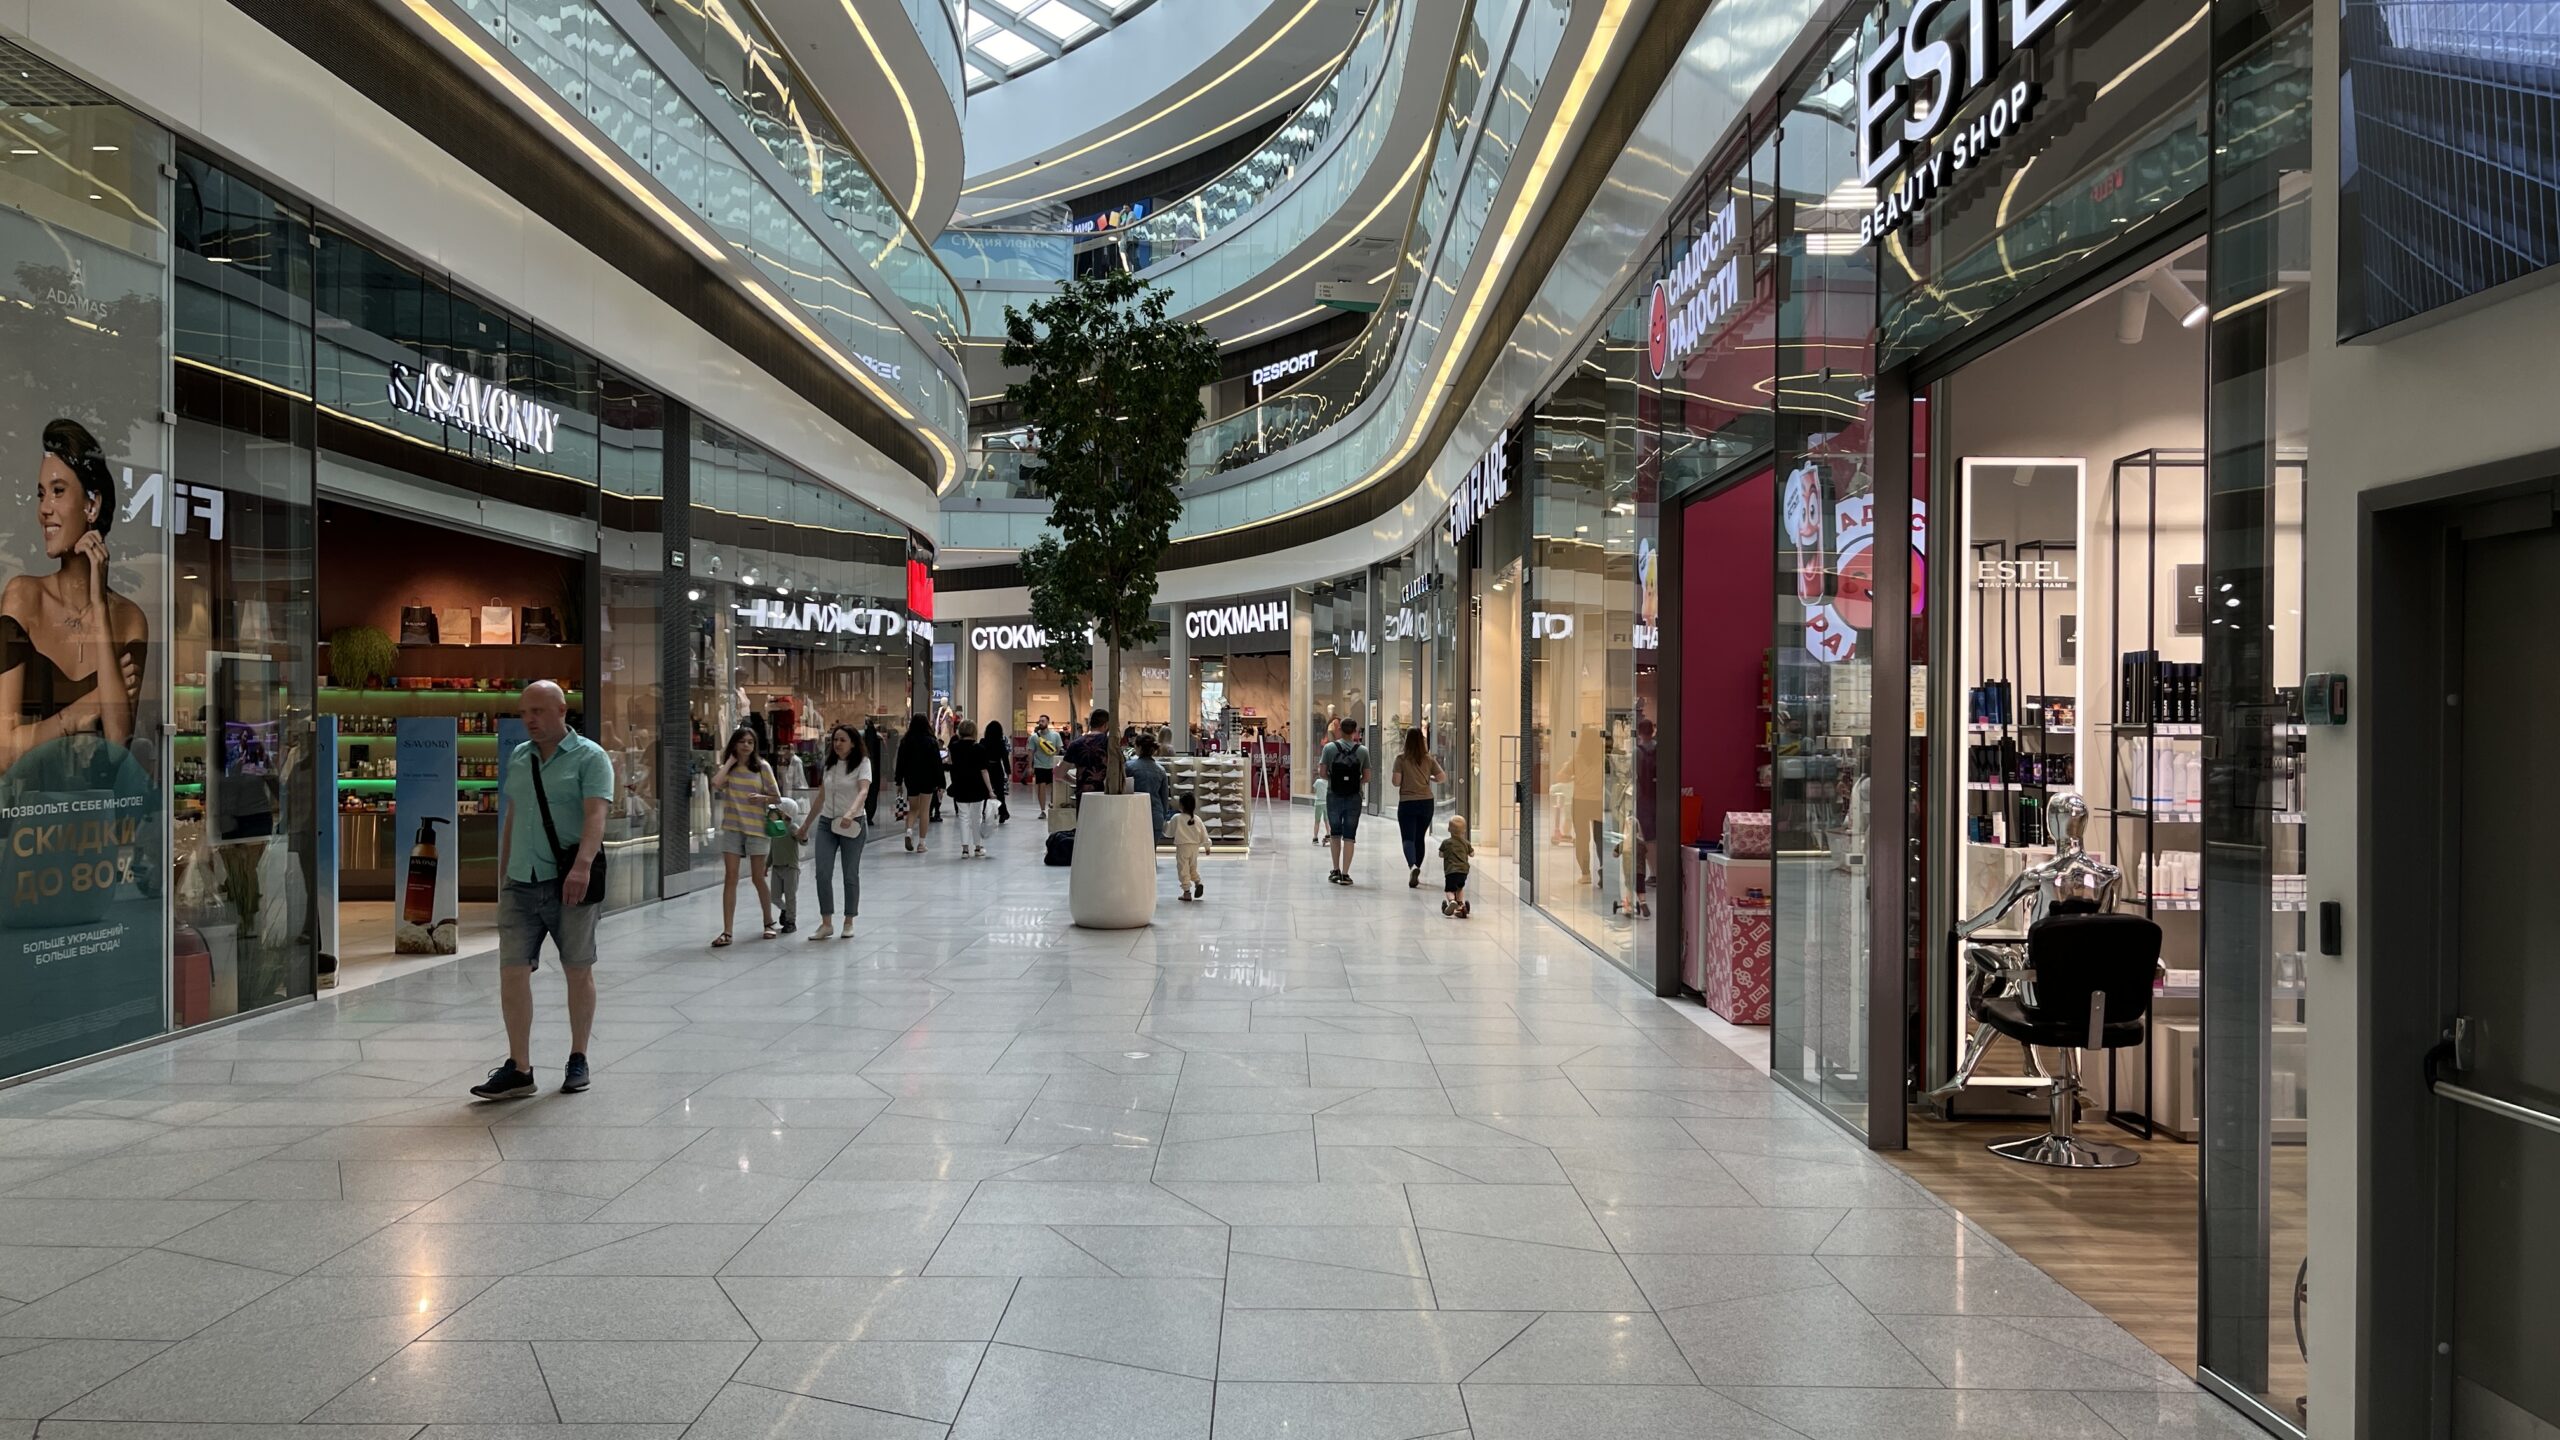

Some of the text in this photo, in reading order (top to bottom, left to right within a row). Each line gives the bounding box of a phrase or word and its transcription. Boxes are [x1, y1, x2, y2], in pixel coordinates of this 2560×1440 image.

[1861, 80, 2027, 246] BEAUTY SHOP
[951, 236, 1050, 250] Студия лепки
[1668, 197, 1737, 306] СЛАДОСТИ
[46, 287, 108, 318] ADAMAS
[1669, 255, 1738, 363] РАДОСТИ
[1252, 349, 1319, 386] DESPORT
[1449, 428, 1508, 547] FINN FLARE
[1978, 560, 2069, 580] ESTEL
[1185, 600, 1289, 639] СТОКМАНН
[2, 795, 144, 819] ПОЗВОЛЬТЕ СЕБЕ МНОГОЕ!
[12, 814, 137, 858] СКИДКИ
[12, 856, 135, 908] ДО 80%
[23, 935, 66, 954] БОЛЬШЕ
[67, 922, 124, 945] УКРАШЕНИЙ
[35, 938, 121, 965] БОЛЬШЕ ВЫГОДА!
